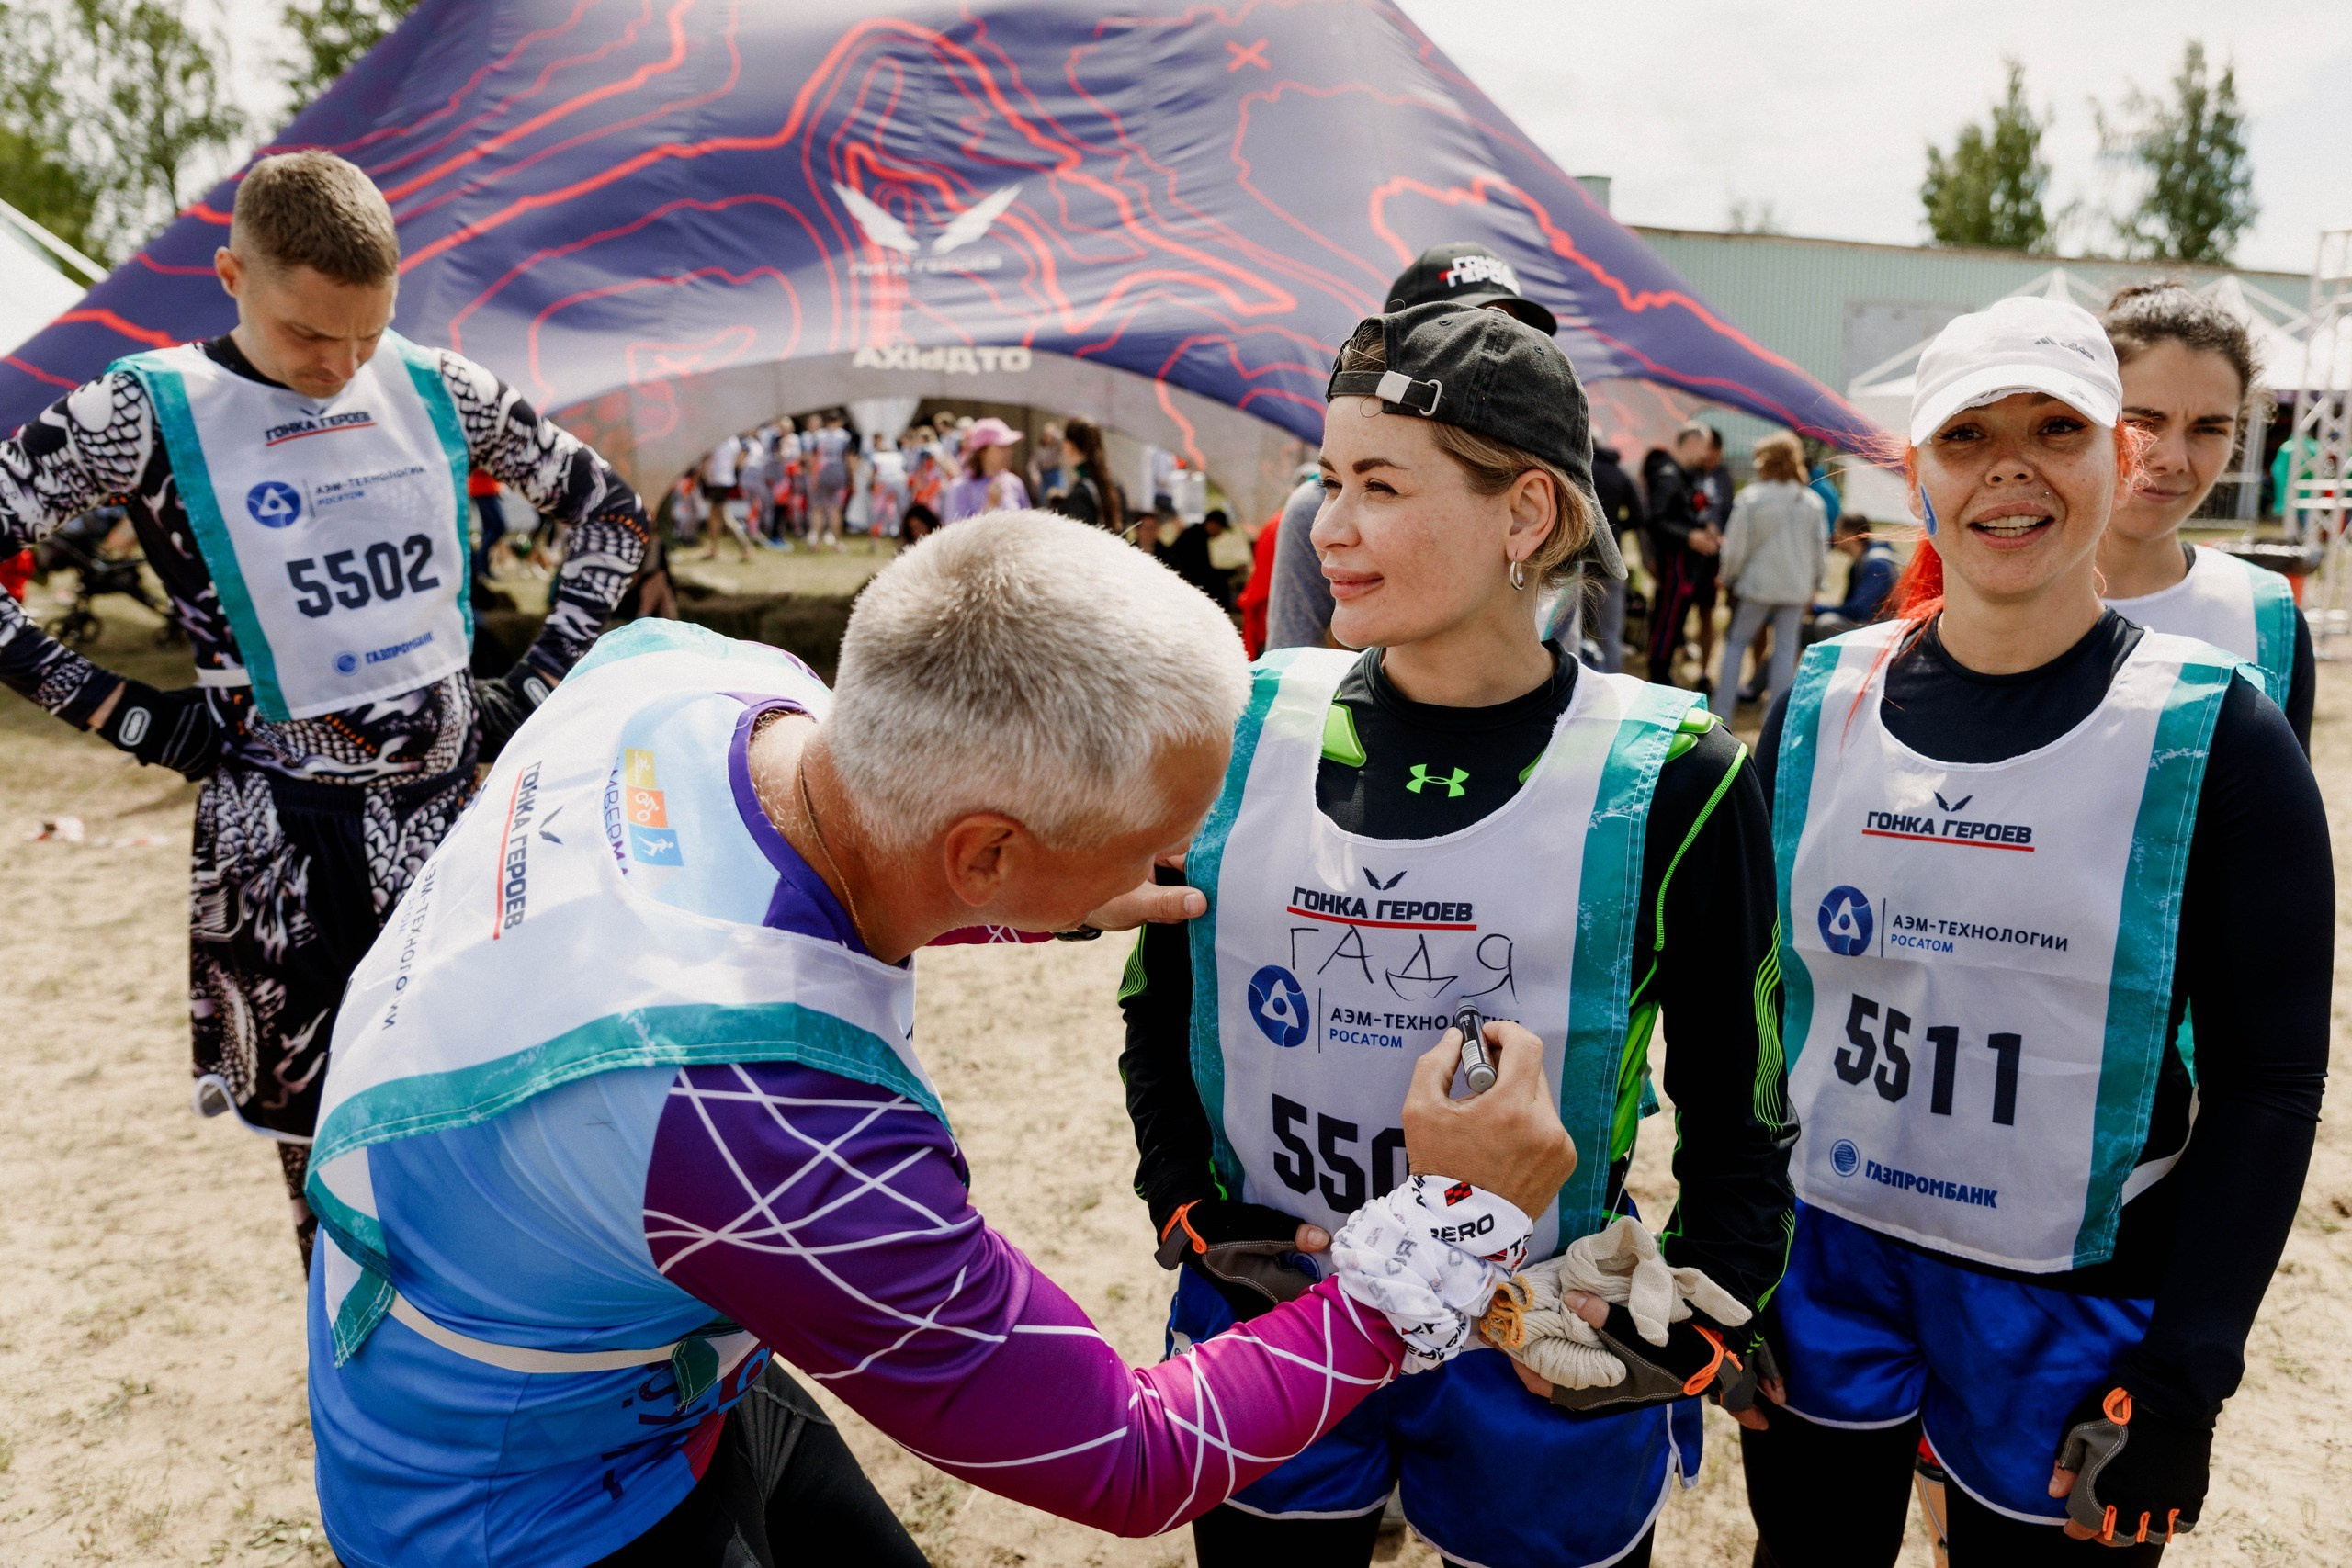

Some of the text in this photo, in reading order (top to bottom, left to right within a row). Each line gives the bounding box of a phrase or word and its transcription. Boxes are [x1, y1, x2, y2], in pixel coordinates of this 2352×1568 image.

[265, 411, 371, 441] ГОНКА ГЕРОЕВ
[286, 533, 440, 618] 5502
[503, 760, 543, 930] ГОНКА ГЕРОЕВ
[1866, 811, 2033, 844] ГОНКА ГЕРОЕВ
[1292, 886, 1474, 922] ГОНКА ГЕРОЕВ
[1890, 933, 1954, 953] РОСАТОМ
[1892, 914, 2068, 953] АЭМ-ТЕХНОЛОГИИ
[1329, 1027, 1403, 1049] РОСАТОМ
[1833, 993, 2022, 1126] 5511
[1271, 1092, 1409, 1214] 550
[1865, 1158, 1998, 1209] ГАЗПРОМБАНК
